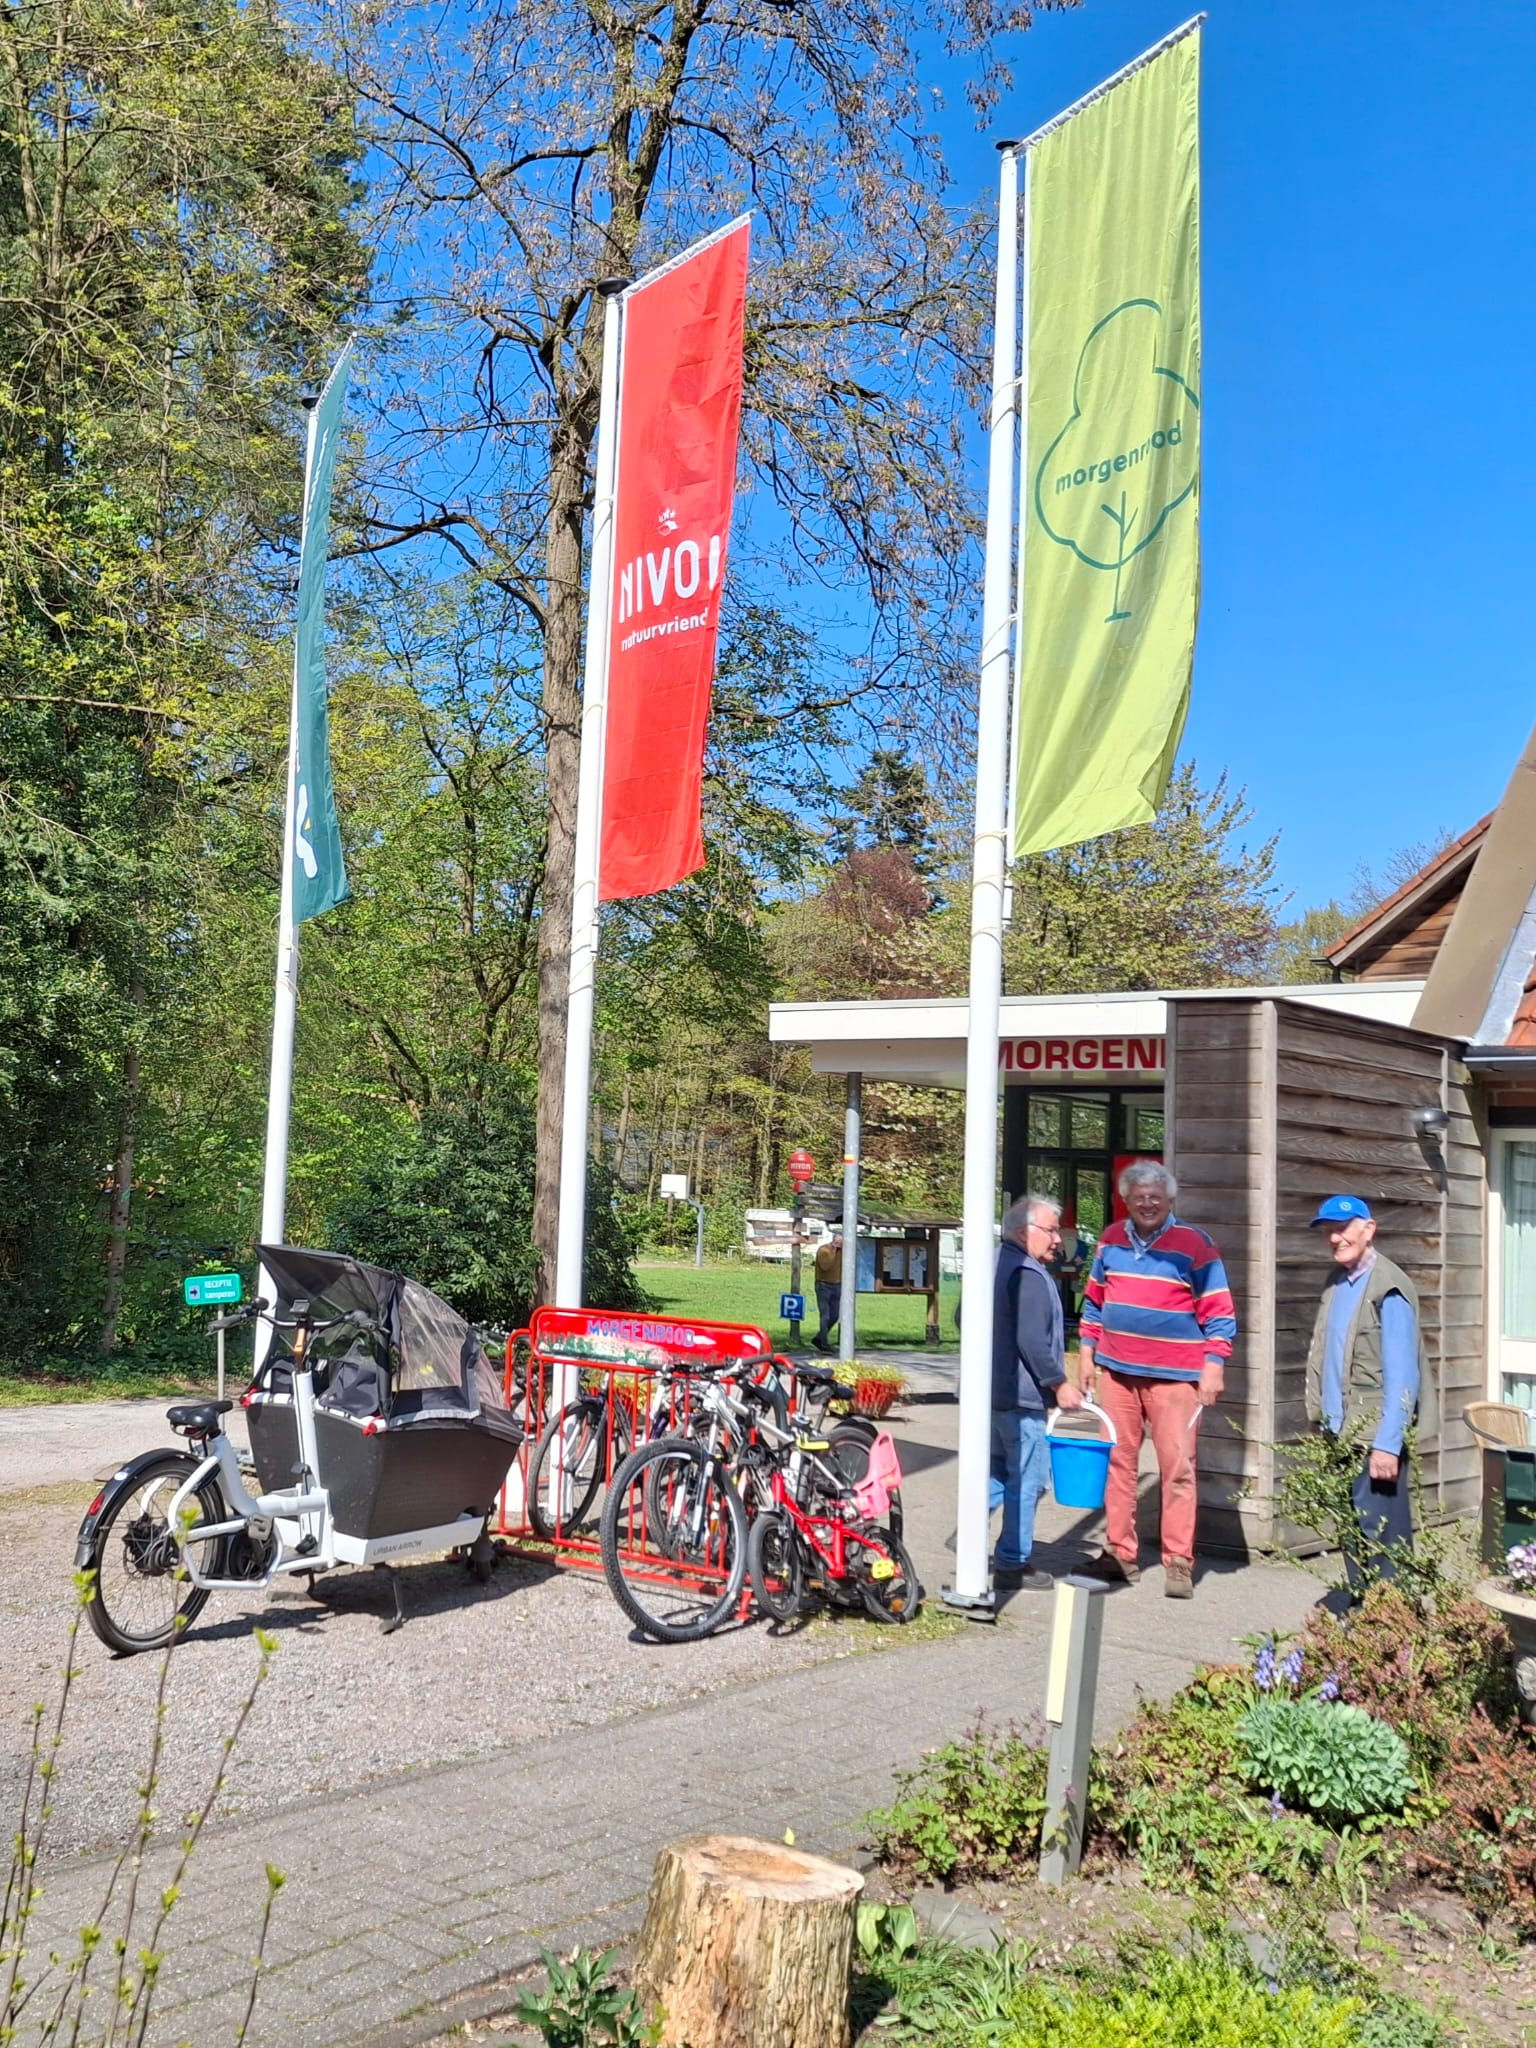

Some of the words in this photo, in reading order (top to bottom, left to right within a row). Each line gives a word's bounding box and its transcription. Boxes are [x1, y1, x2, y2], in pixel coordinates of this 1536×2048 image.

[1056, 419, 1182, 494] morgenrod
[998, 1038, 1166, 1070] ORGEN
[783, 1296, 798, 1316] P
[373, 1544, 398, 1556] URBAN
[398, 1539, 423, 1551] ARROW
